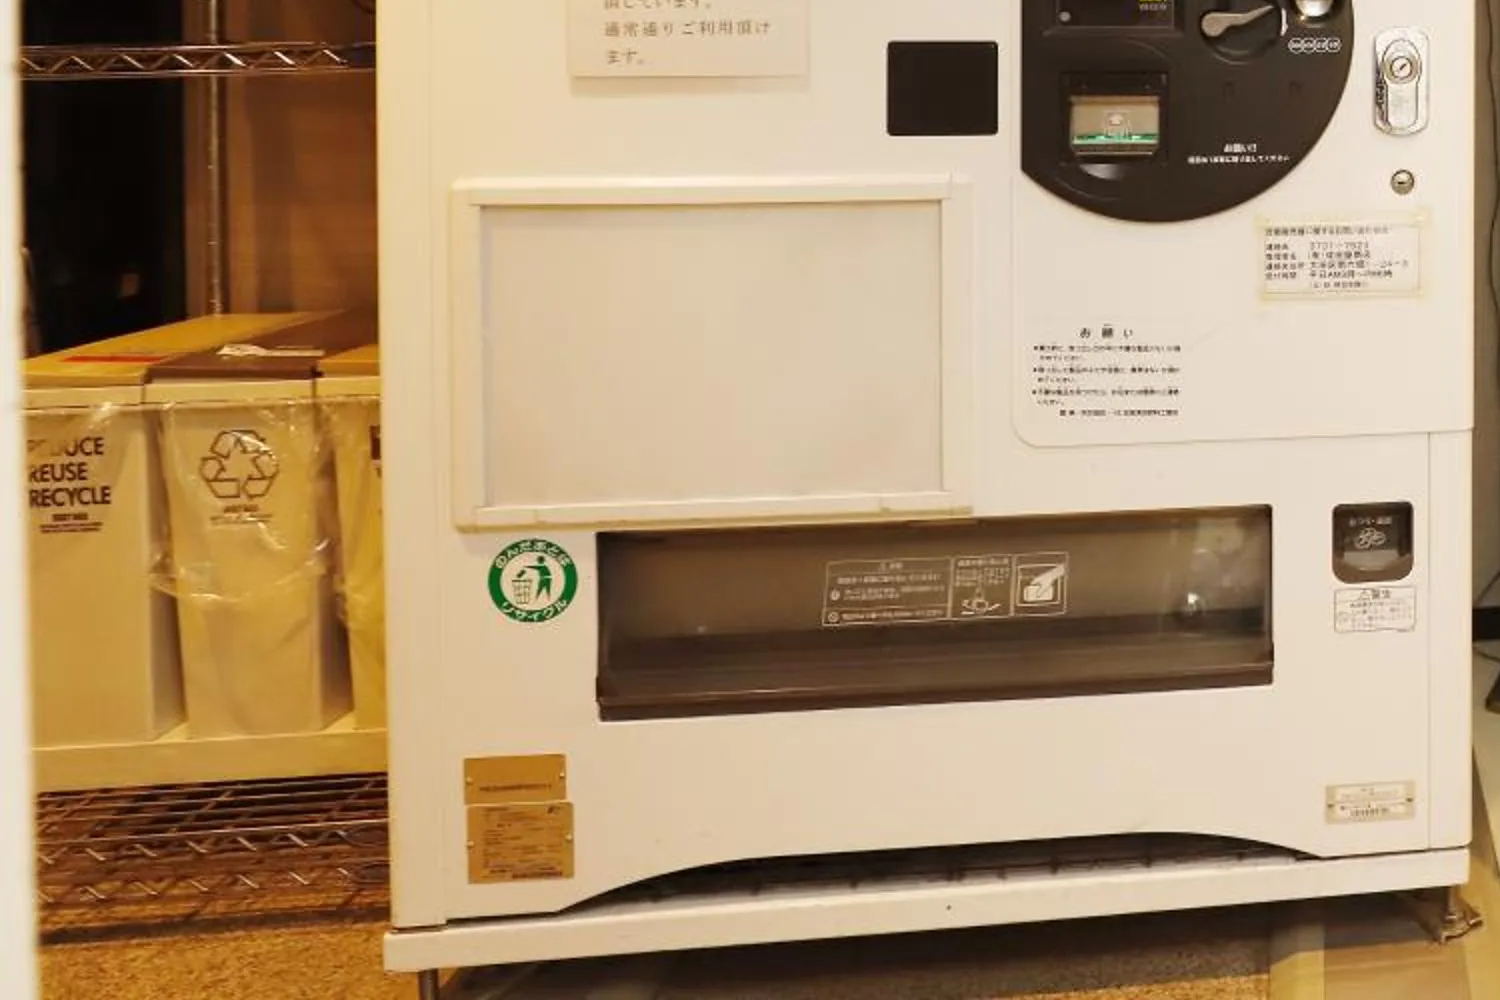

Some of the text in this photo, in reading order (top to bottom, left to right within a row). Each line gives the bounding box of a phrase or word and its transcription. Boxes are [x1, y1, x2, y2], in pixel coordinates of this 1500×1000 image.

[606, 50, 646, 65] ます。
[29, 462, 89, 483] REUSE
[29, 486, 112, 508] RECYCLE
